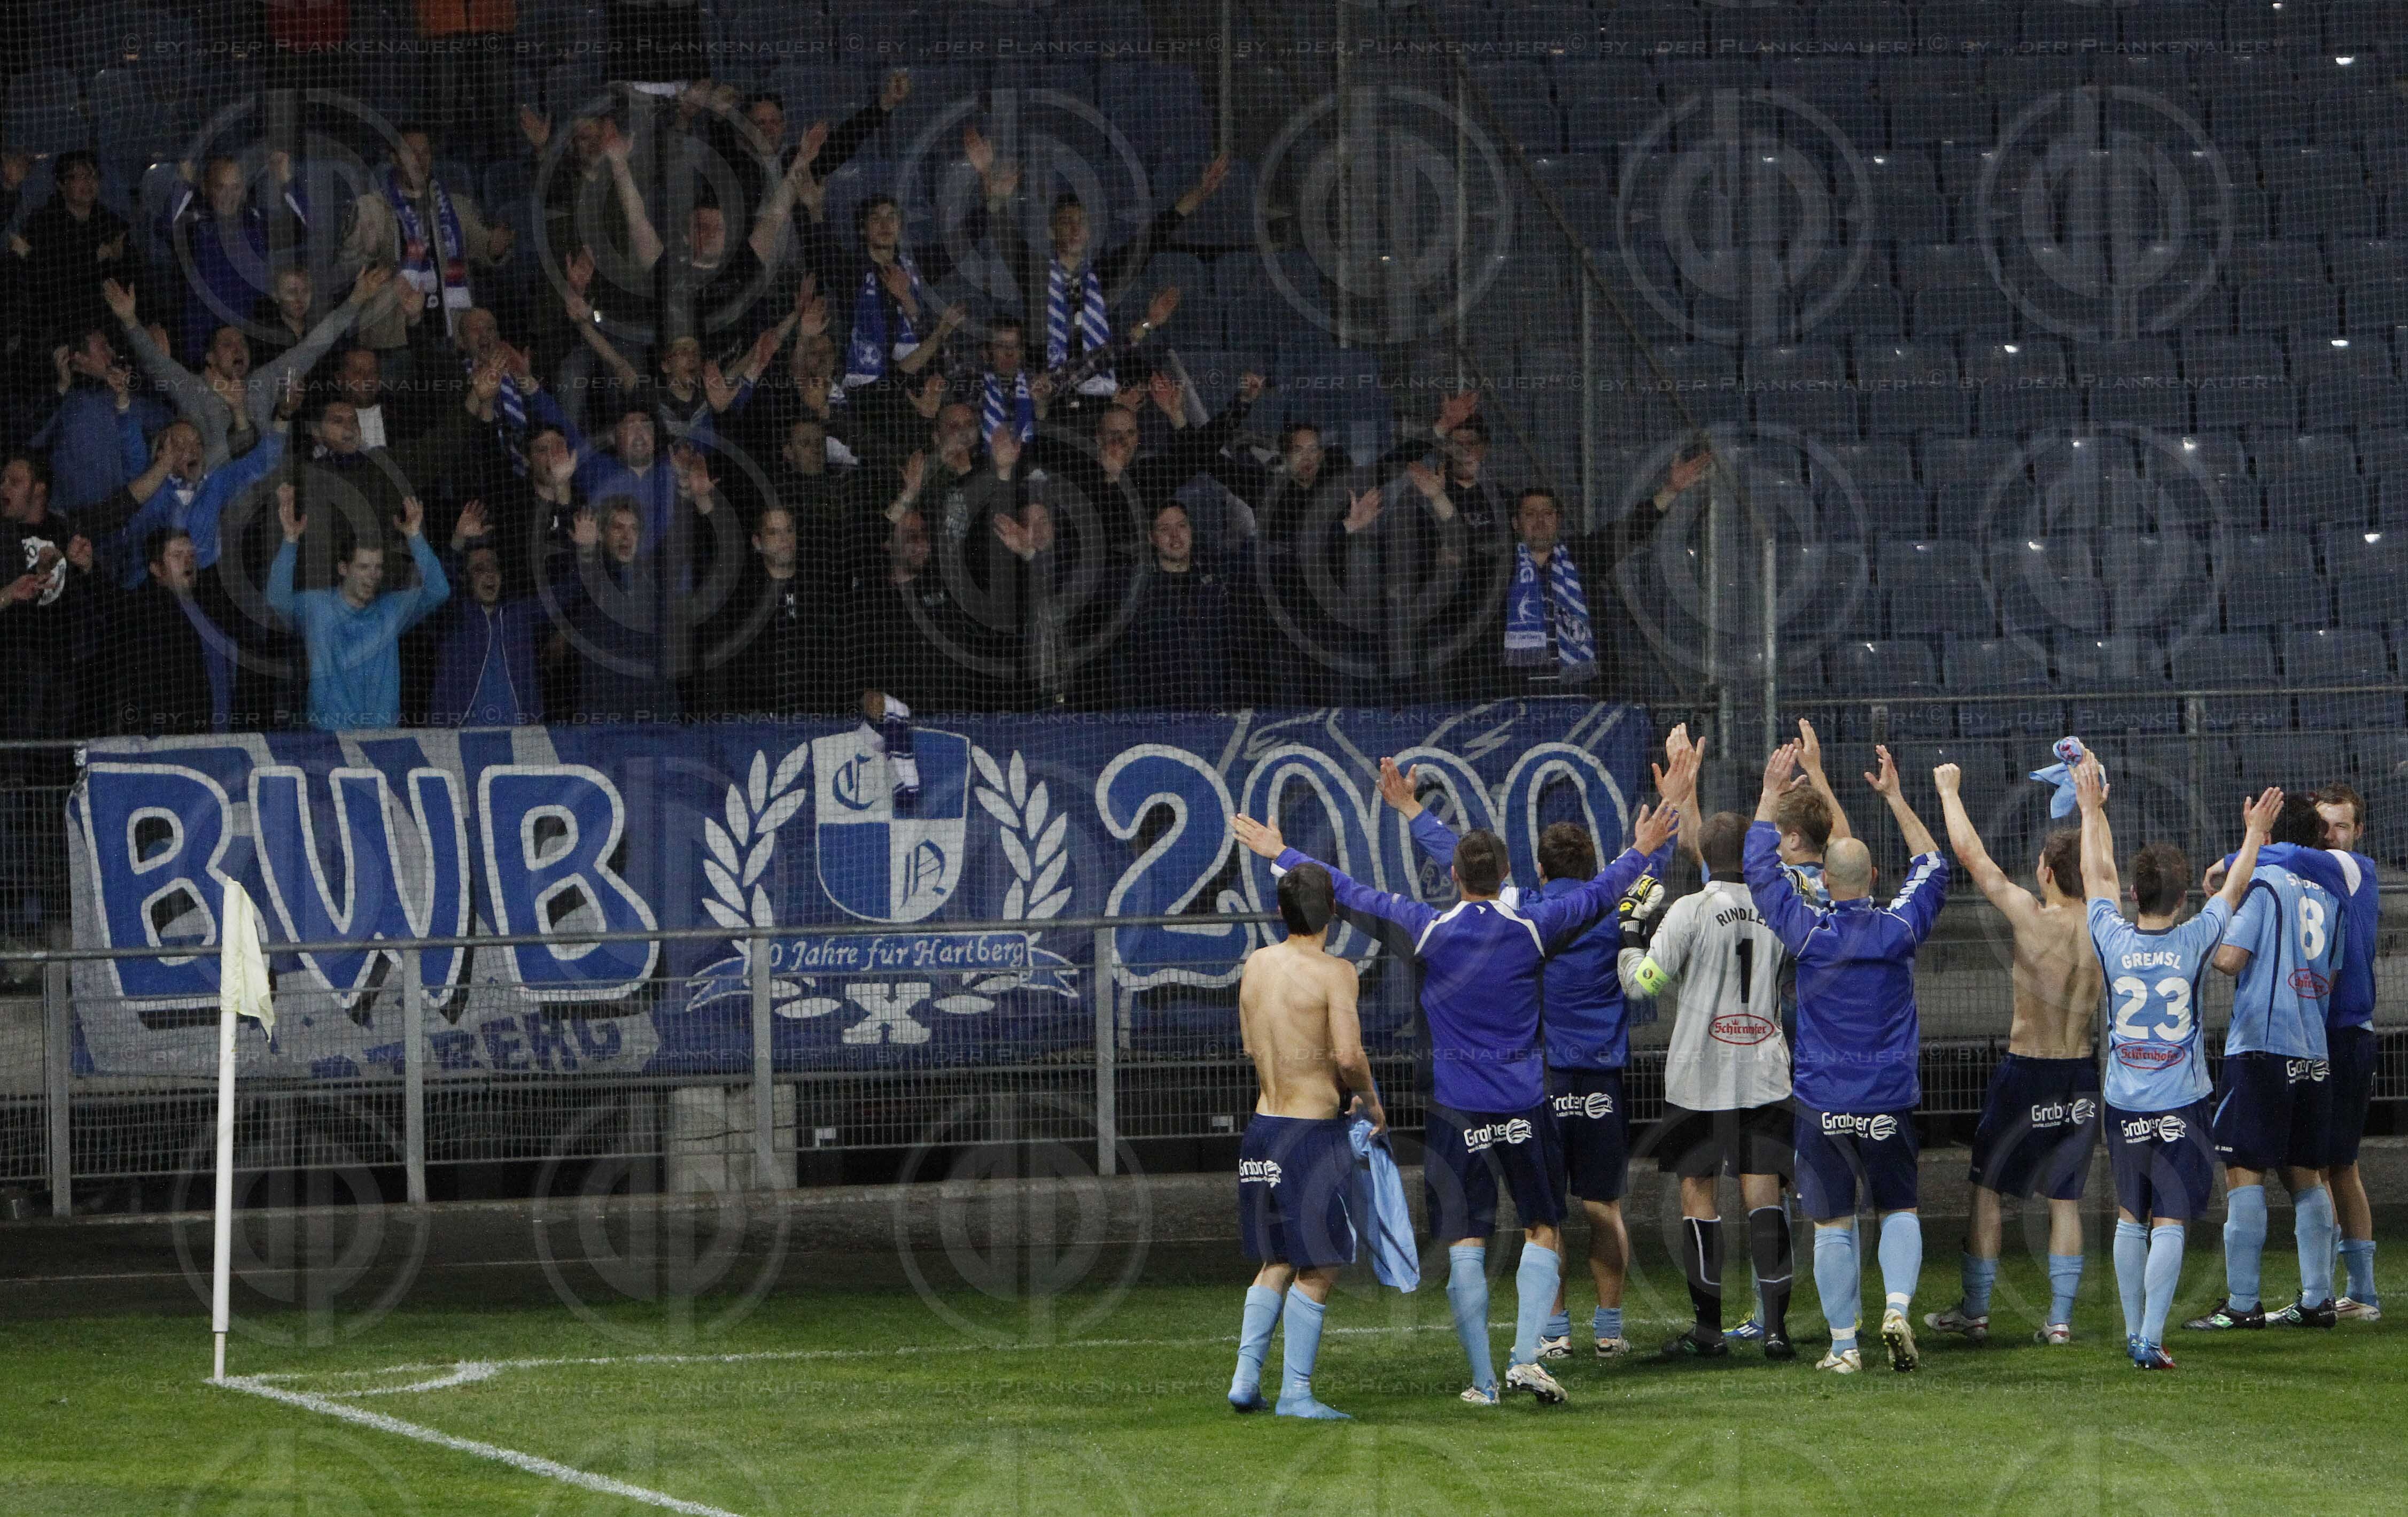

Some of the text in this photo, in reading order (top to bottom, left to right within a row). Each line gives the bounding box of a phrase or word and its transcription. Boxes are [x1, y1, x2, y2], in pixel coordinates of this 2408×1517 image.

[86, 762, 659, 1009] BWB
[1095, 741, 1629, 992] 2000
[789, 937, 859, 971] Jahre
[859, 938, 909, 972] für
[913, 935, 1024, 968] Hartberg
[2121, 951, 2181, 970] GREMSL
[2298, 898, 2326, 961] 8
[1735, 938, 1753, 1004] 1
[2112, 976, 2192, 1042] 23
[1821, 1111, 1871, 1131] Graber
